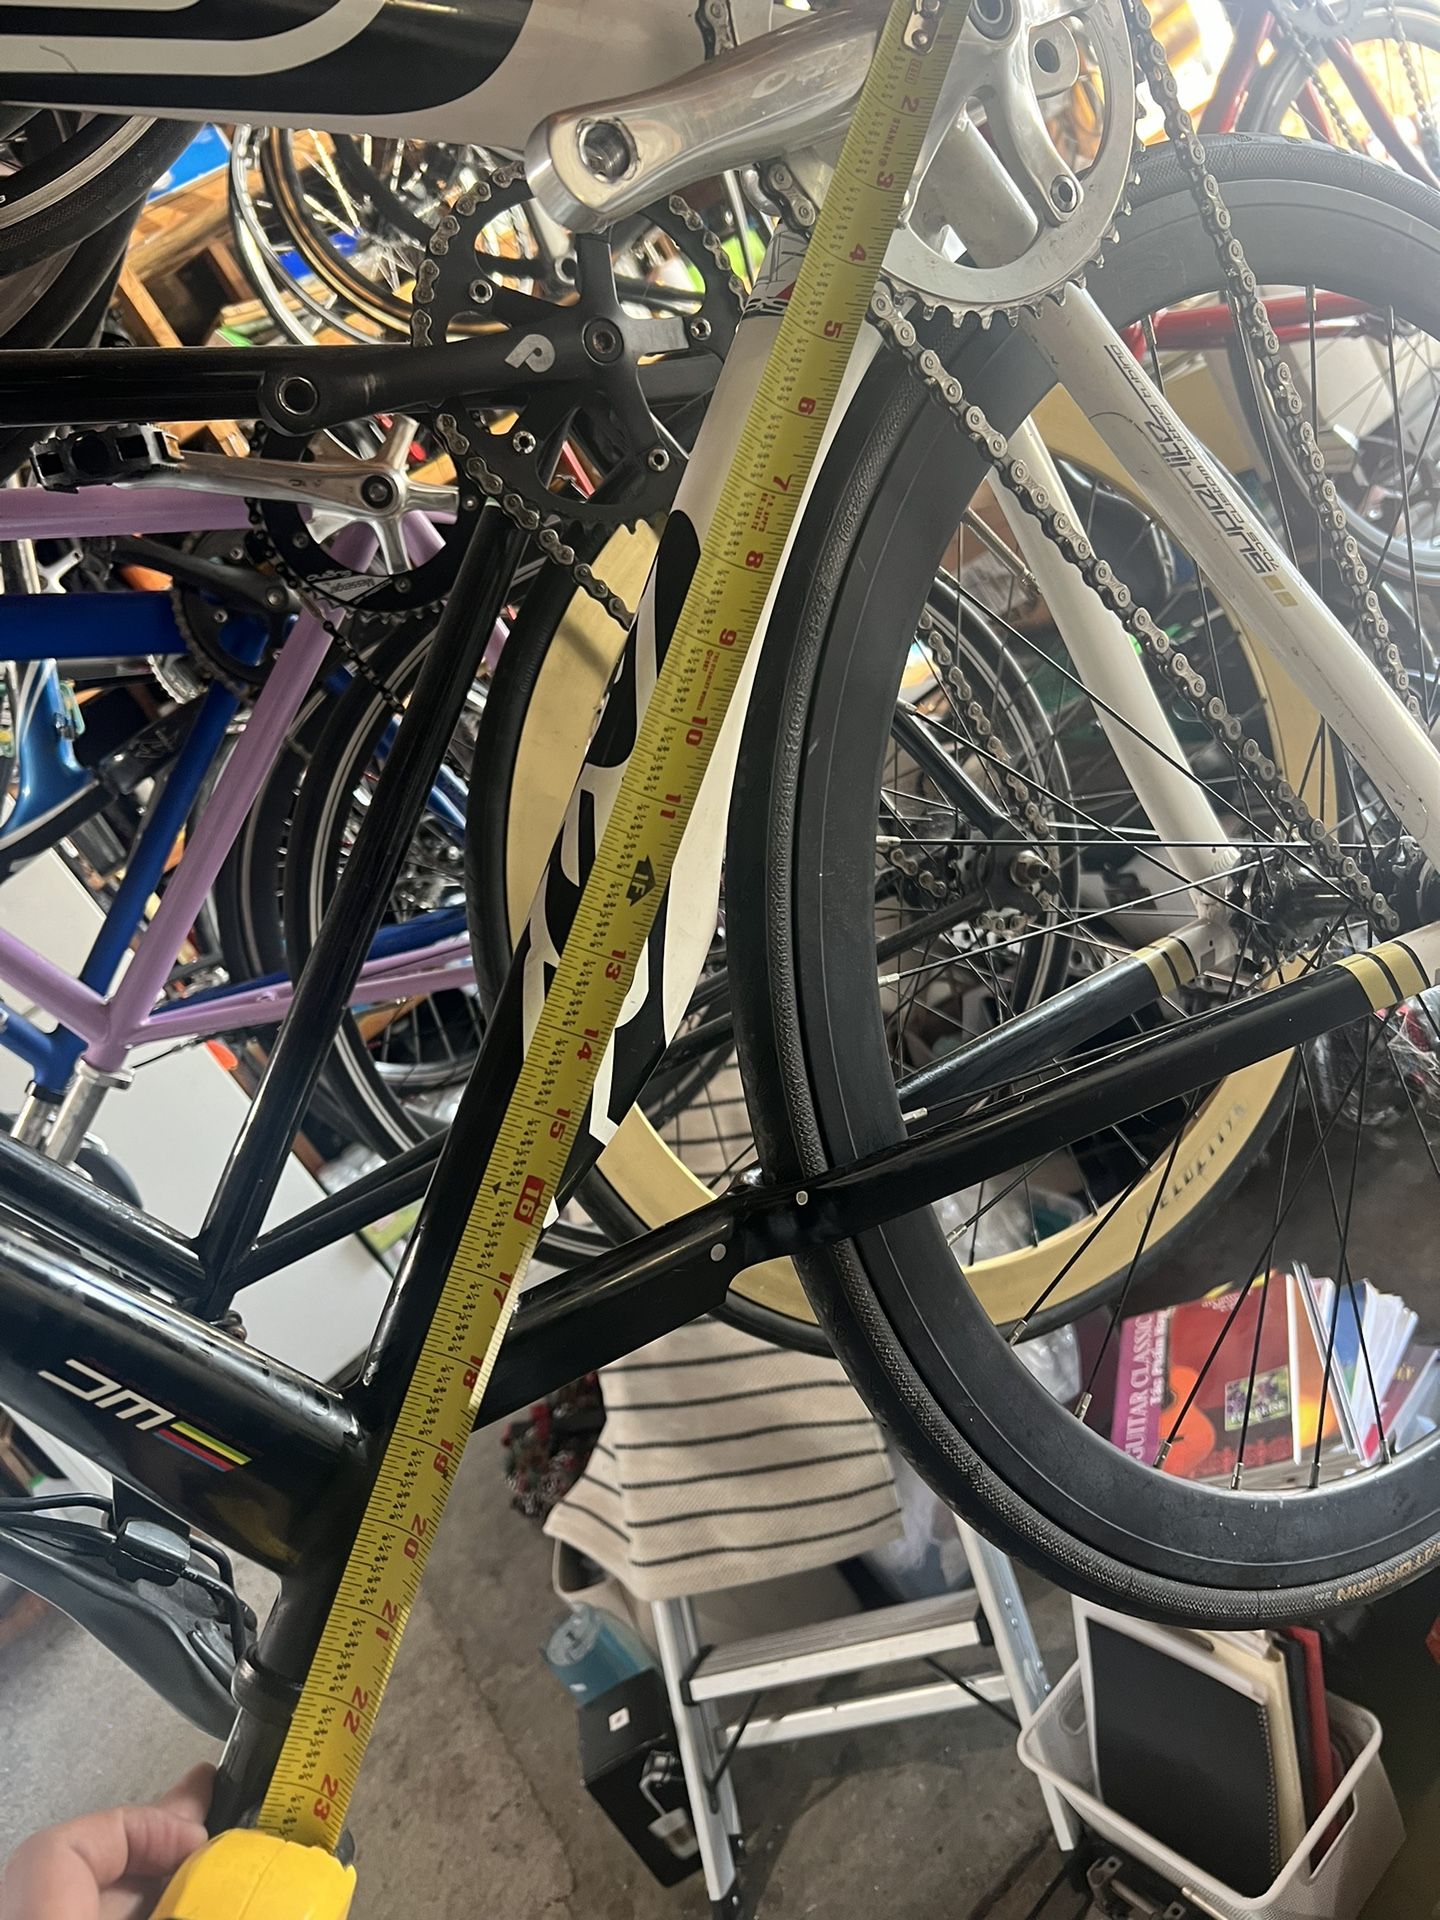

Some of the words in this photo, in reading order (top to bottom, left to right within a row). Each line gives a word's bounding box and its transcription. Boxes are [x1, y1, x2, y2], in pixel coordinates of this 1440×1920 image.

[901, 95, 921, 112] 2
[876, 171, 895, 189] 3
[850, 243, 868, 262] 4
[823, 319, 843, 339] 5
[1110, 344, 1151, 398] tubing
[797, 396, 817, 416] 6
[1150, 404, 1197, 461] butted
[773, 473, 792, 492] 7
[1145, 419, 1271, 574] superlite
[1197, 465, 1245, 524] custom
[745, 551, 764, 569] 8
[719, 628, 738, 647] 9
[686, 715, 709, 746] 10
[660, 794, 682, 820] 11
[605, 950, 627, 981] 13
[577, 1028, 599, 1060] 14
[550, 1108, 572, 1140] 15
[518, 1185, 541, 1219] 16
[493, 1271, 513, 1309] 17
[1131, 1314, 1153, 1389] CLASSIC
[463, 1355, 484, 1390] 18
[1125, 1388, 1149, 1461] GUITAR
[433, 1439, 455, 1473] 19
[404, 1513, 428, 1560] 20
[375, 1599, 399, 1641] 21
[343, 1686, 369, 1734] 22
[312, 1774, 340, 1822] 23
